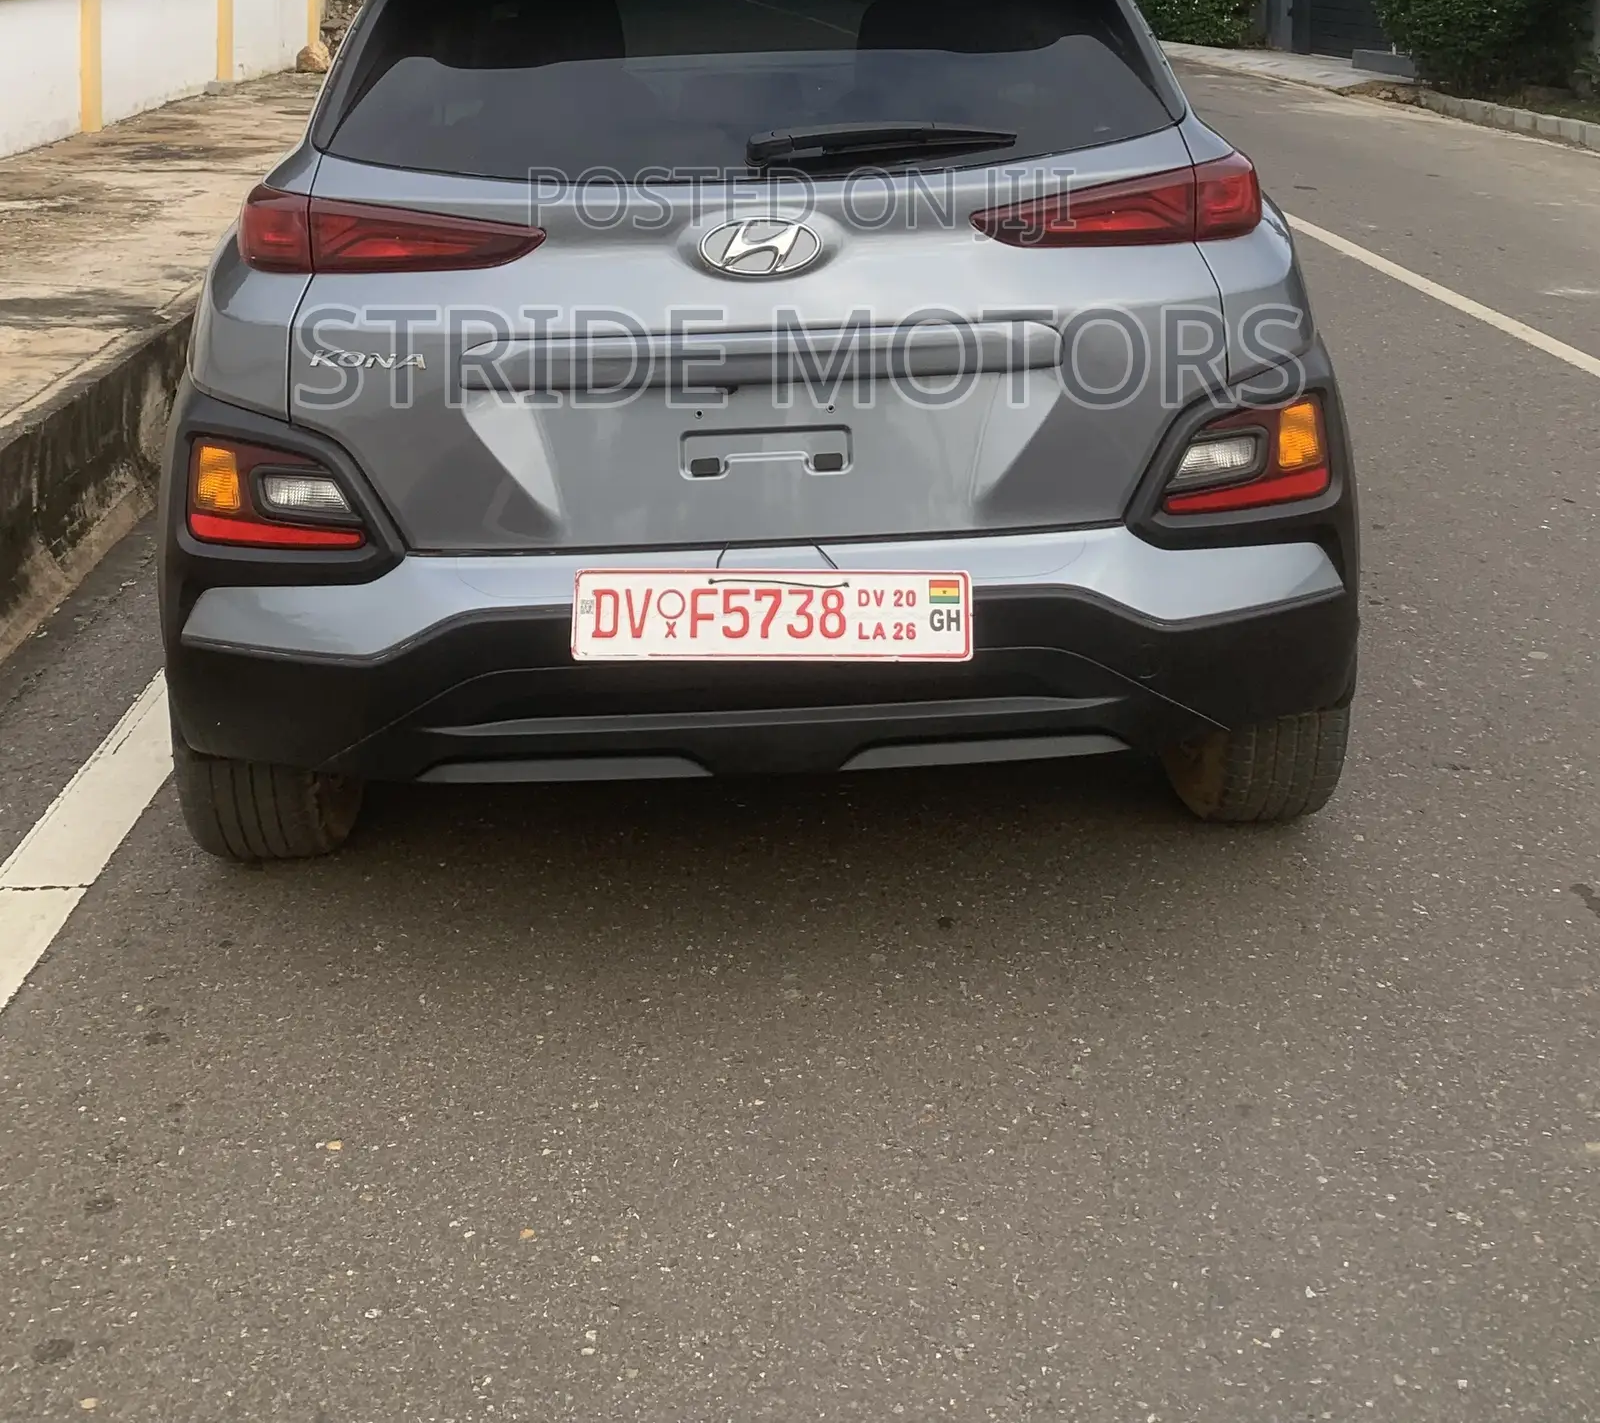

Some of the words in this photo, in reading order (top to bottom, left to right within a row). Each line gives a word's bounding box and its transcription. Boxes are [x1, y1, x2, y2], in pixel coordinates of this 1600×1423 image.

[310, 350, 426, 369] KONA
[858, 589, 884, 607] DV
[893, 589, 916, 607] 20
[929, 609, 960, 632] GH
[858, 622, 886, 640] LA
[893, 622, 916, 640] 26
